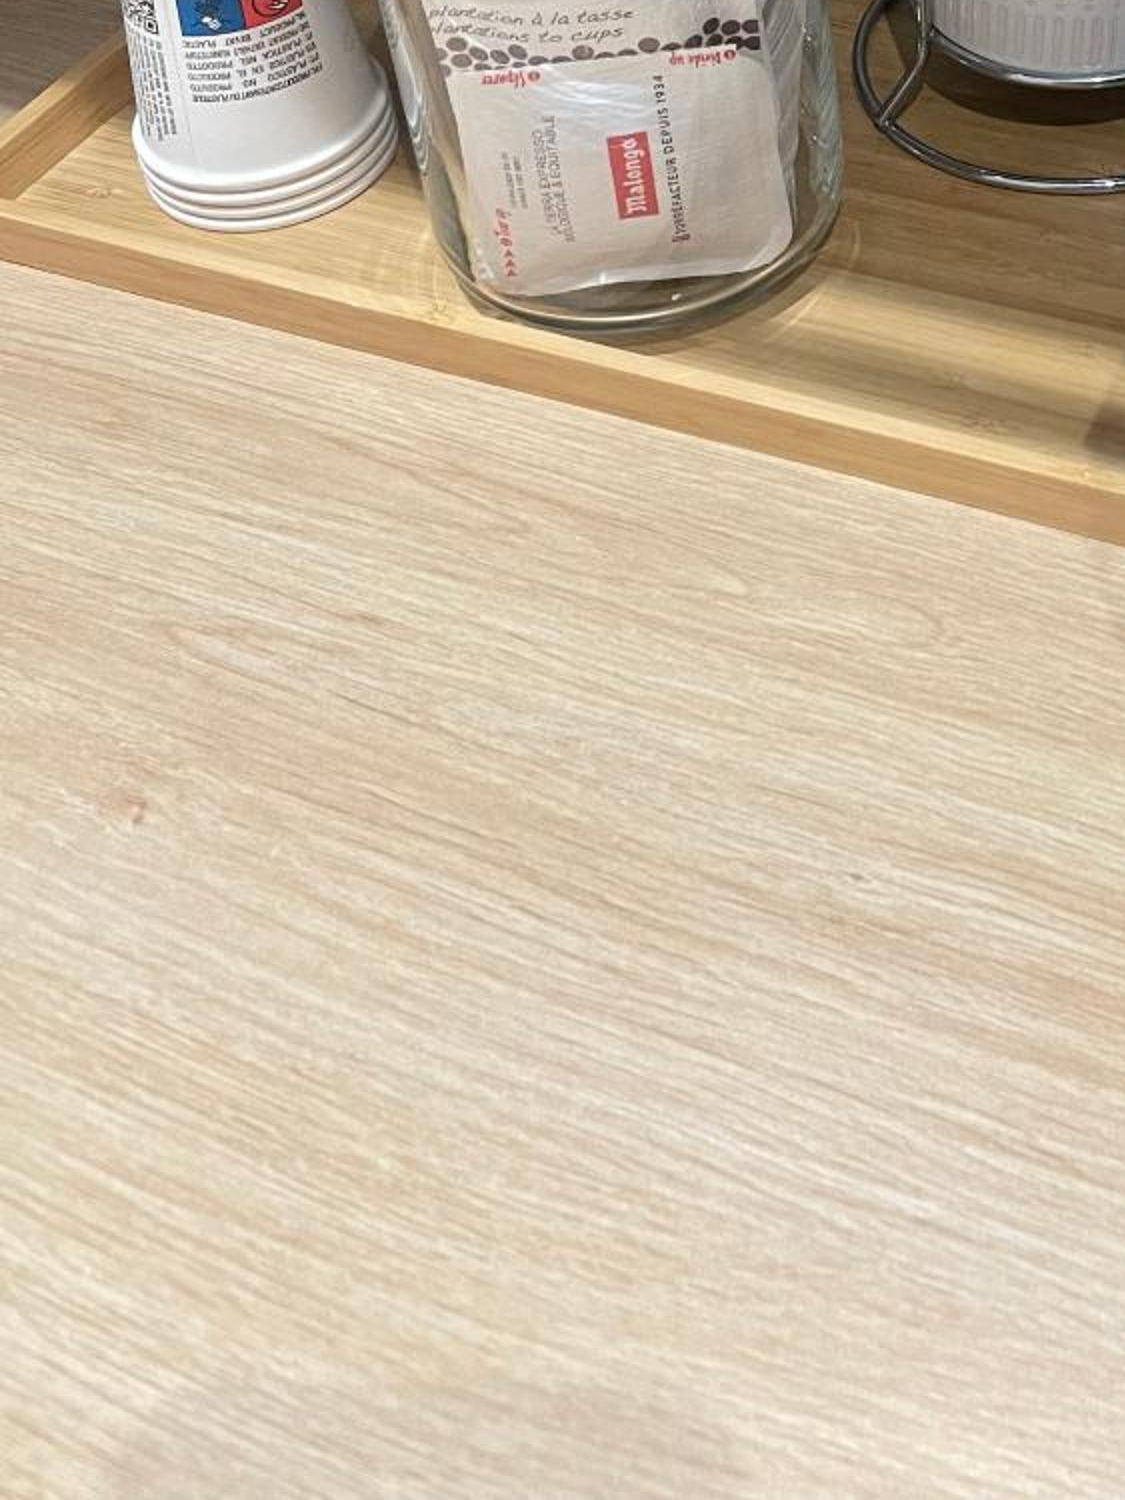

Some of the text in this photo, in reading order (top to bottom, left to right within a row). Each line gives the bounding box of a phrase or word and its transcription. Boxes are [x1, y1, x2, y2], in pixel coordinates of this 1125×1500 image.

[429, 5, 634, 27] plantation à la tasse
[538, 30, 562, 42] to
[571, 27, 624, 45] cups
[652, 75, 666, 103] 1934
[657, 107, 675, 154] DEPUIS
[618, 137, 648, 213] Malongo
